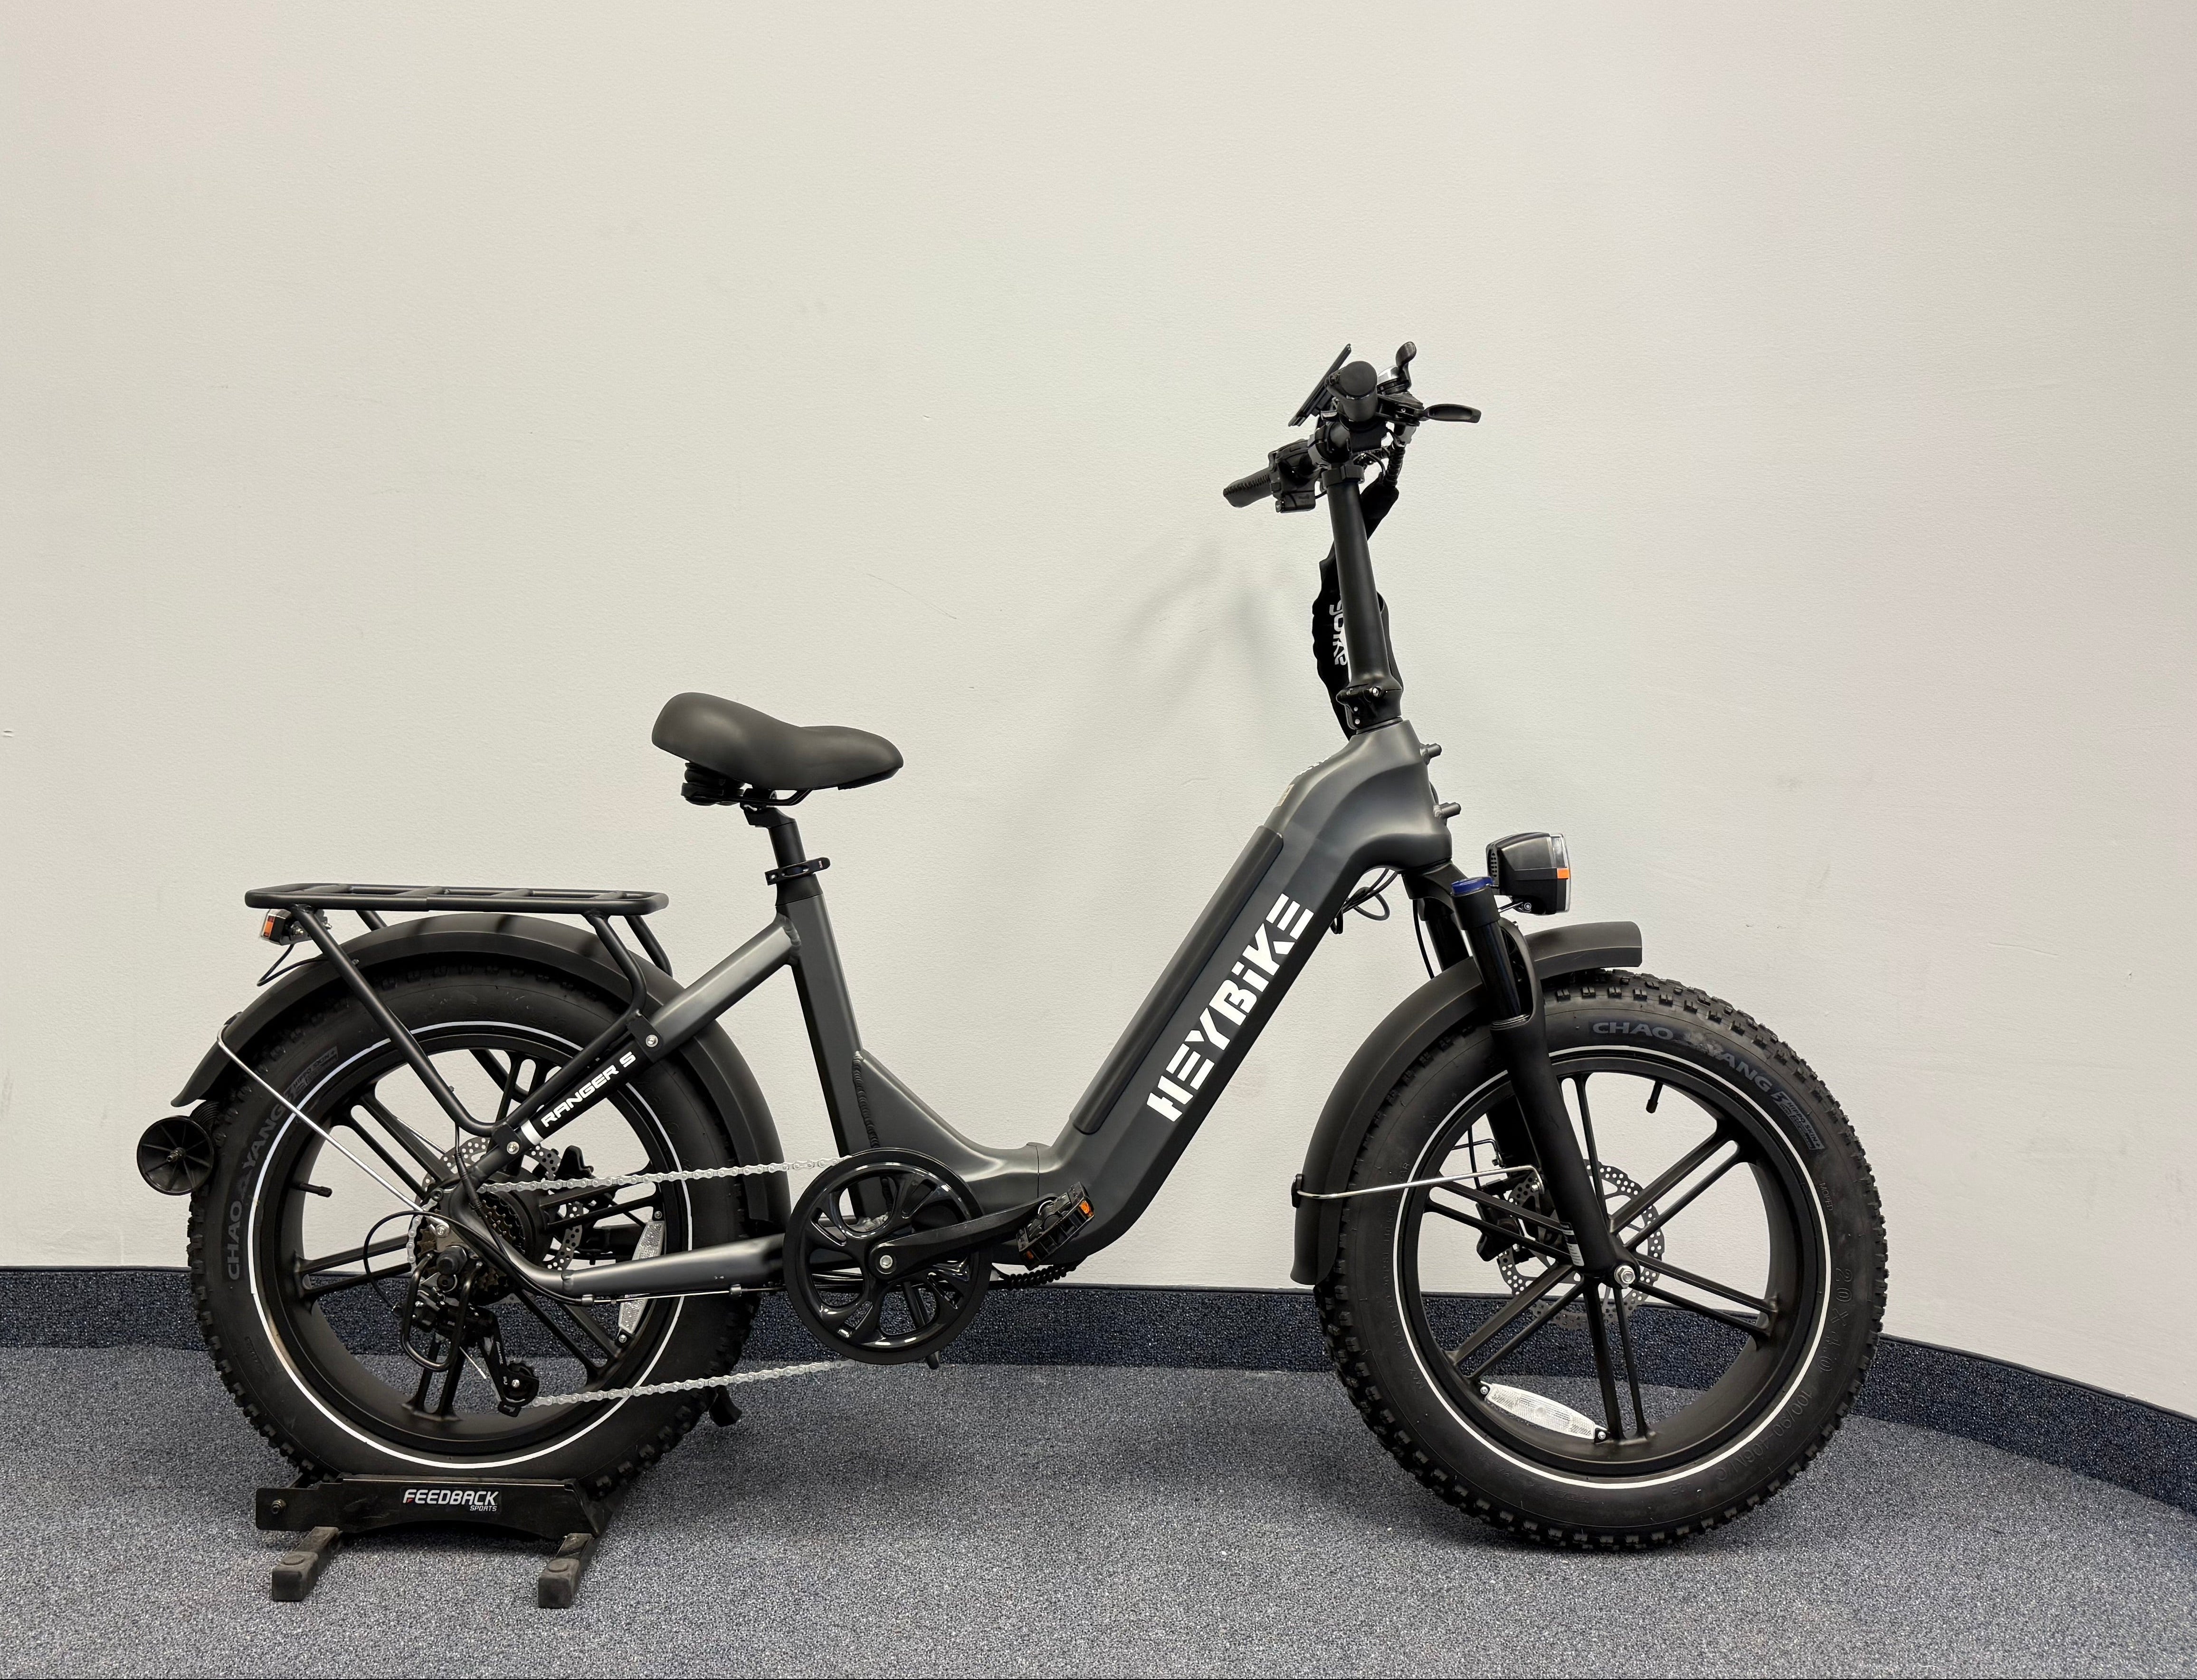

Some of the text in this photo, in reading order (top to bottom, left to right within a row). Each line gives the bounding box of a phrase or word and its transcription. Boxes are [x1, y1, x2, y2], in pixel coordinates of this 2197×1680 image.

[1592, 1022, 1773, 1093] CHAO YANG
[541, 1065, 619, 1128] RANGER
[619, 1051, 636, 1068] S
[1788, 1102, 1806, 1123] HIPPO
[228, 1103, 285, 1281] CHAO YANG
[1818, 1182, 1834, 1211] MOPED
[403, 1489, 499, 1506] FEEDBACK
